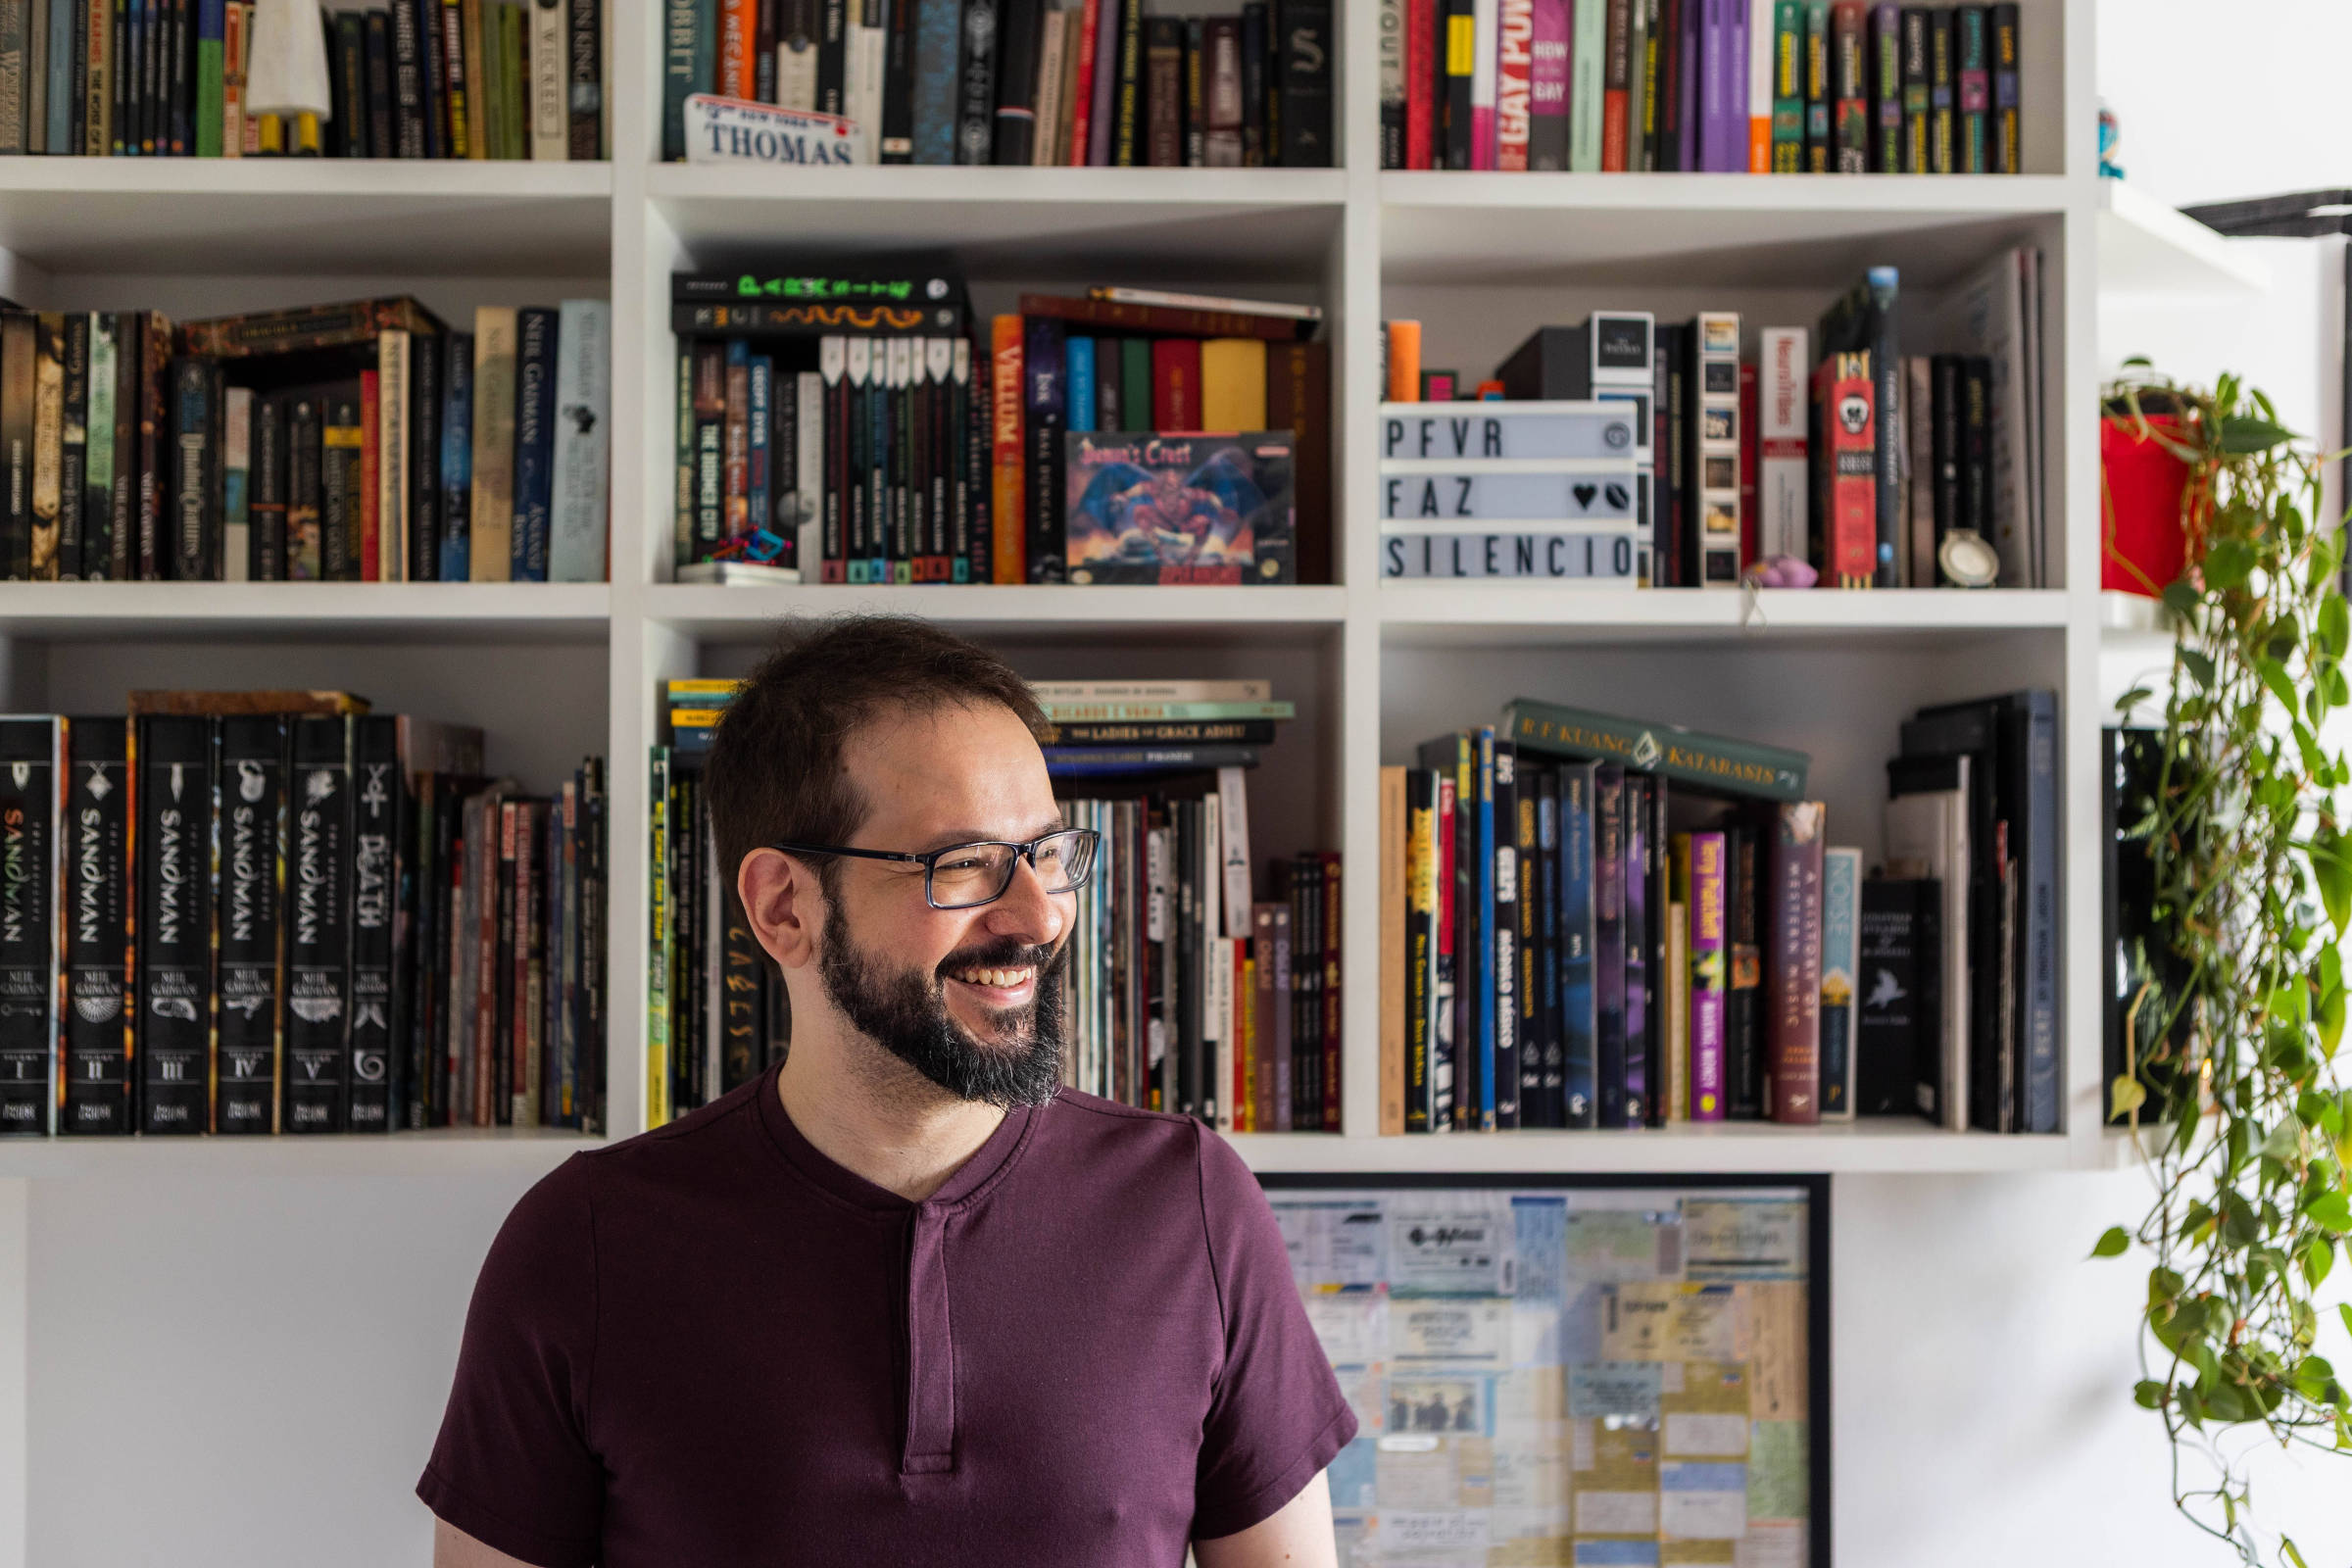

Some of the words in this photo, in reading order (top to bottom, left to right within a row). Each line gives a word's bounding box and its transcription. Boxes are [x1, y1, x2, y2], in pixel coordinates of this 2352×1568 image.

[540, 27, 559, 119] WICKED
[1499, 74, 1531, 143] GAY
[704, 122, 853, 166] THOMAS
[522, 363, 545, 444] GAIMAN
[995, 345, 1023, 444] VELLUM
[1386, 417, 1503, 458] PFVR
[1386, 477, 1473, 517] FAZ
[1387, 535, 1633, 578] SILENCIO
[1559, 726, 1634, 756] KUANG
[1668, 747, 1777, 785] KATABASIS
[356, 833, 387, 928] DEATH
[1787, 861, 1800, 956] WESTERN
[1830, 858, 1852, 944] NOISE
[1497, 928, 1515, 993] MÓDULO
[1803, 896, 1816, 980] HISTORY
[728, 927, 759, 1037] CAGES
[1786, 962, 1800, 1028] MUSIC
[16, 1061, 24, 1080] I
[87, 1061, 104, 1080] II
[162, 1061, 184, 1080] III
[234, 1058, 257, 1078] IV
[304, 1061, 321, 1079] V
